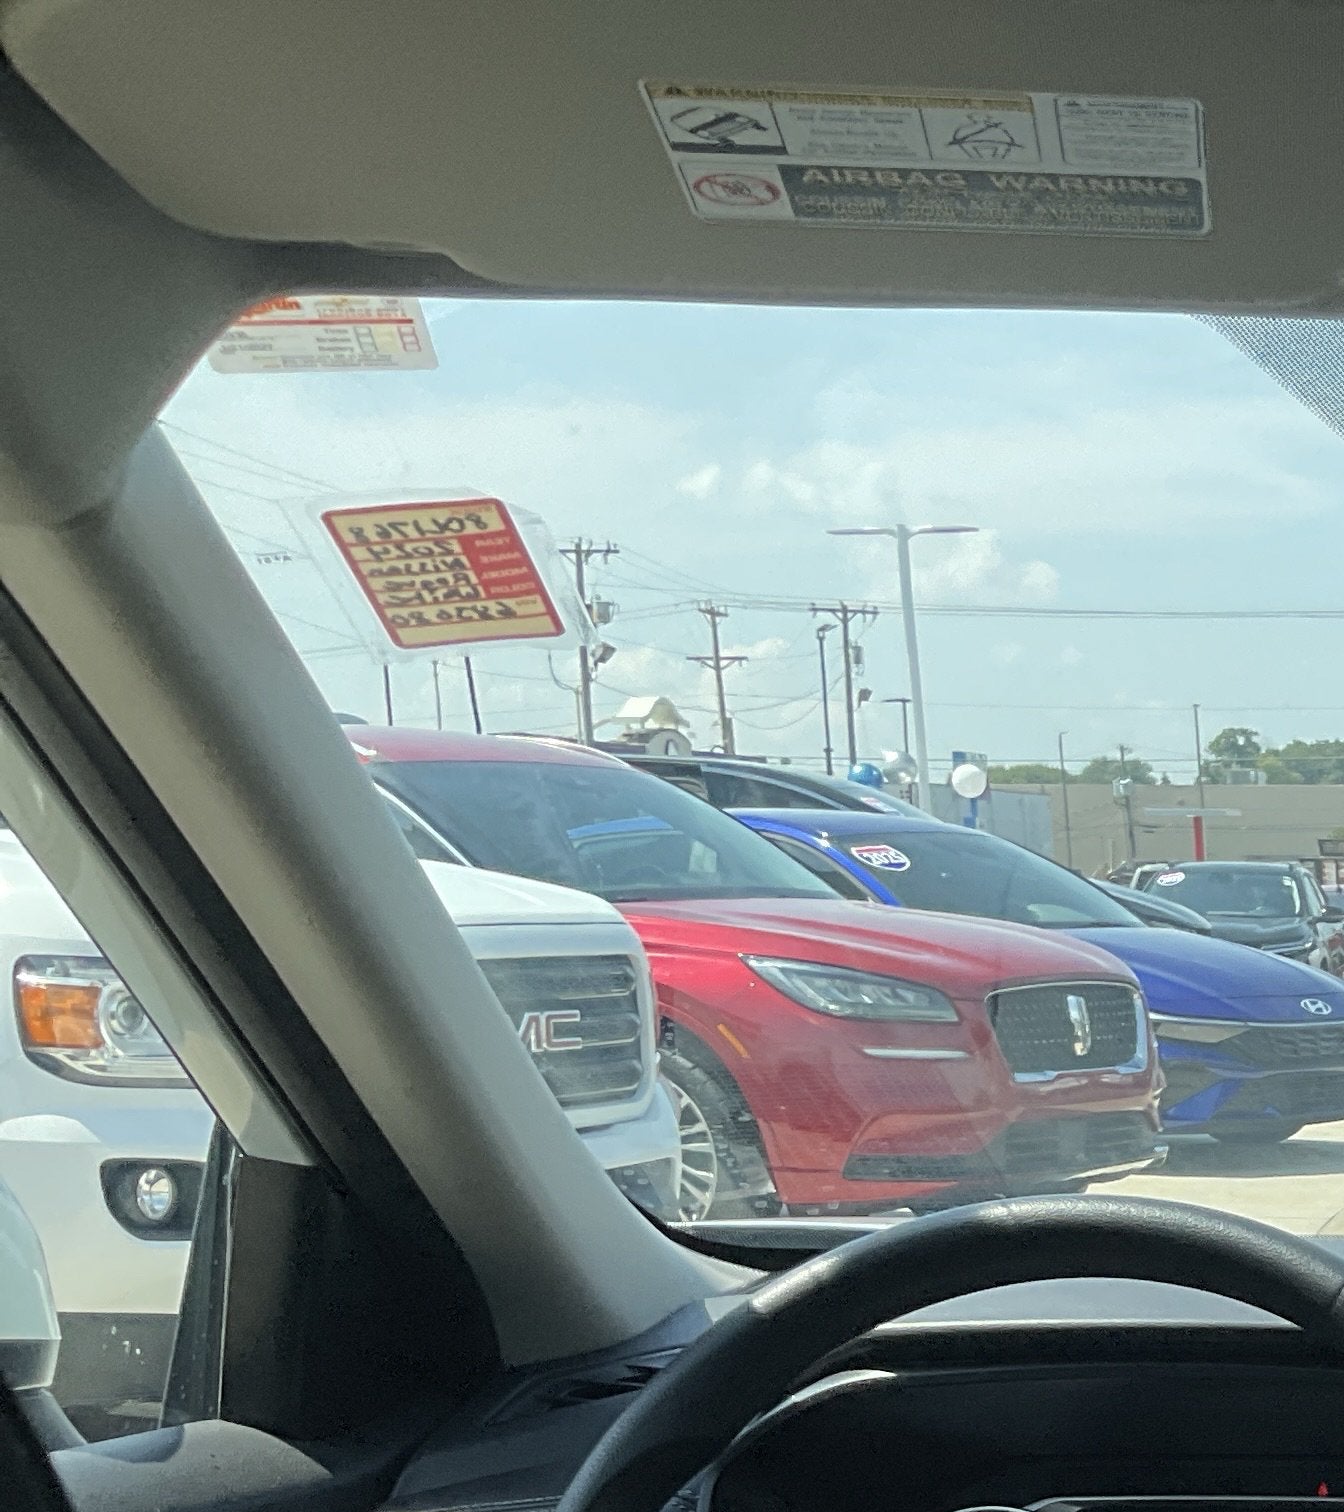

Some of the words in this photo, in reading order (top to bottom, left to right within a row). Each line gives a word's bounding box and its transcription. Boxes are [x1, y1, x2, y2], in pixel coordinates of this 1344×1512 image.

[802, 167, 968, 189] AIRBAG
[986, 173, 1190, 196] WARNING
[863, 851, 902, 865] 2025
